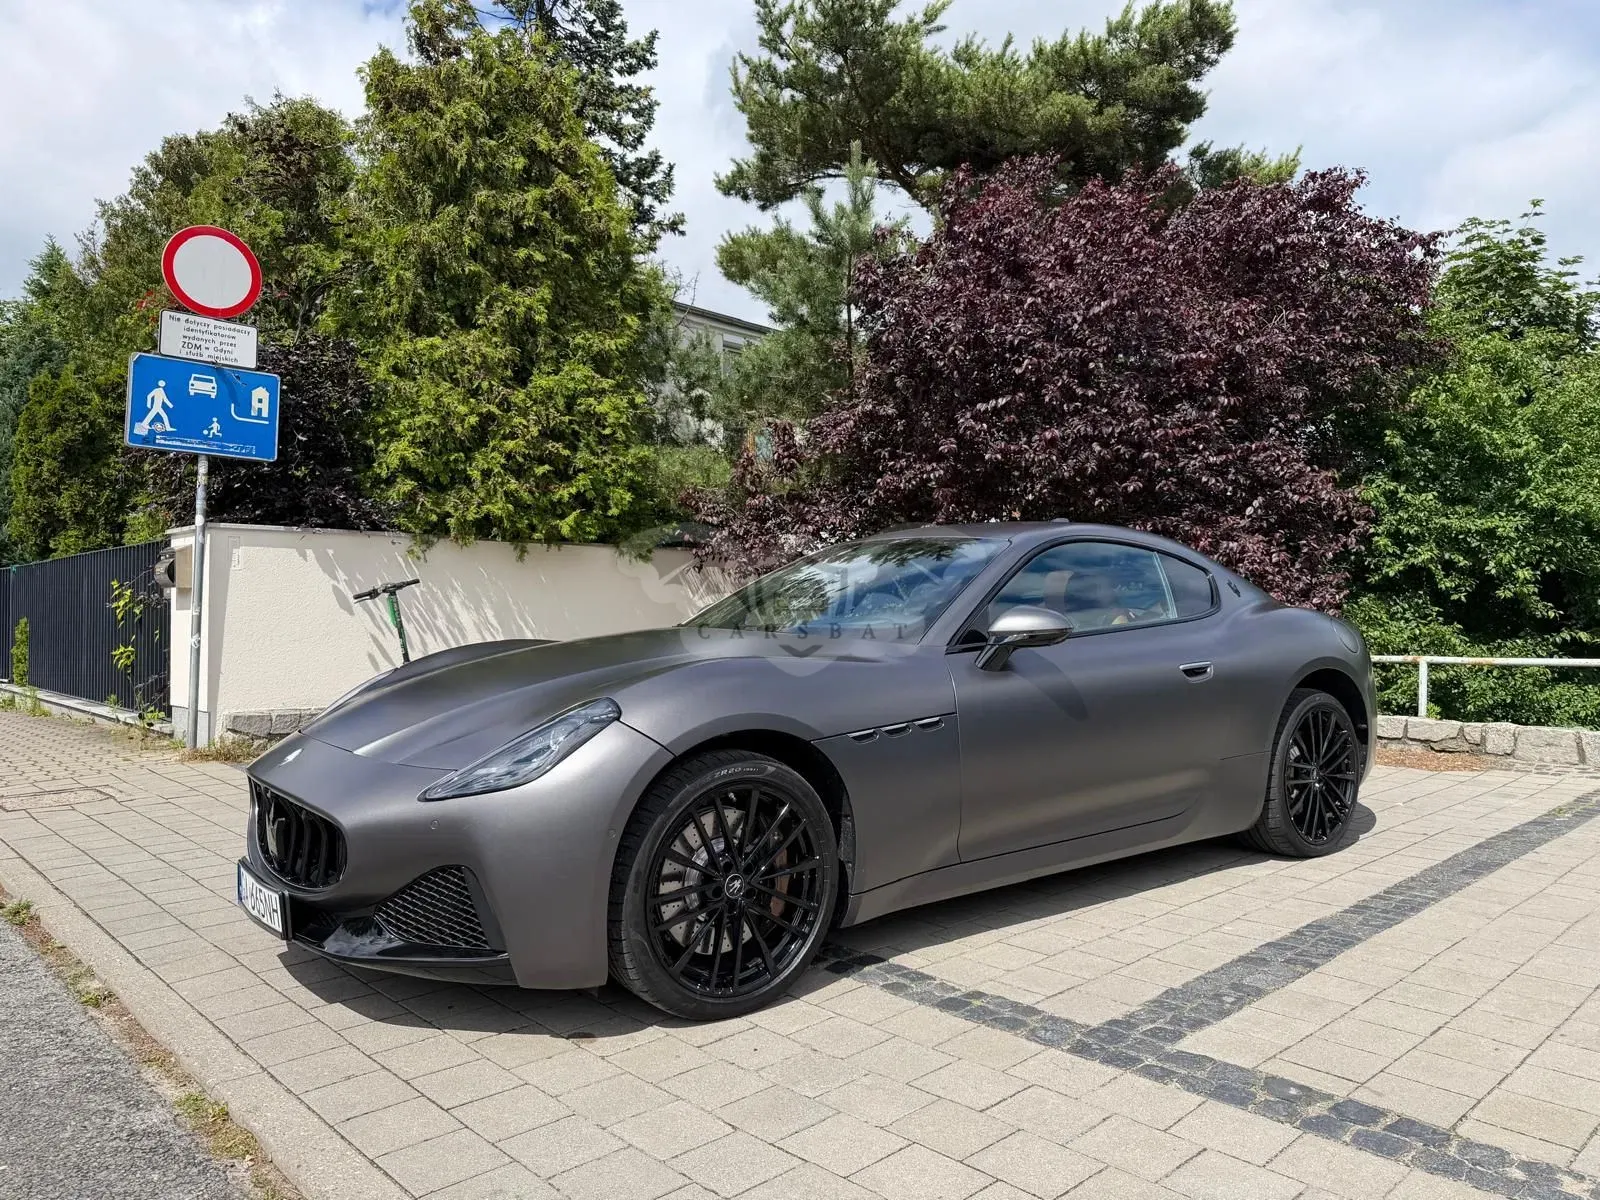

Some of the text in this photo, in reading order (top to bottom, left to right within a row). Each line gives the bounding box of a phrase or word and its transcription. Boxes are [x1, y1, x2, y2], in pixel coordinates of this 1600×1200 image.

[169, 314, 251, 336] Nie dotyczy posiadaczy
[182, 334, 216, 344] wydanych
[183, 326, 237, 340] identyfikatorów
[181, 340, 202, 351] ZDM
[213, 346, 233, 355] Gdyni
[207, 354, 239, 363] miejskich
